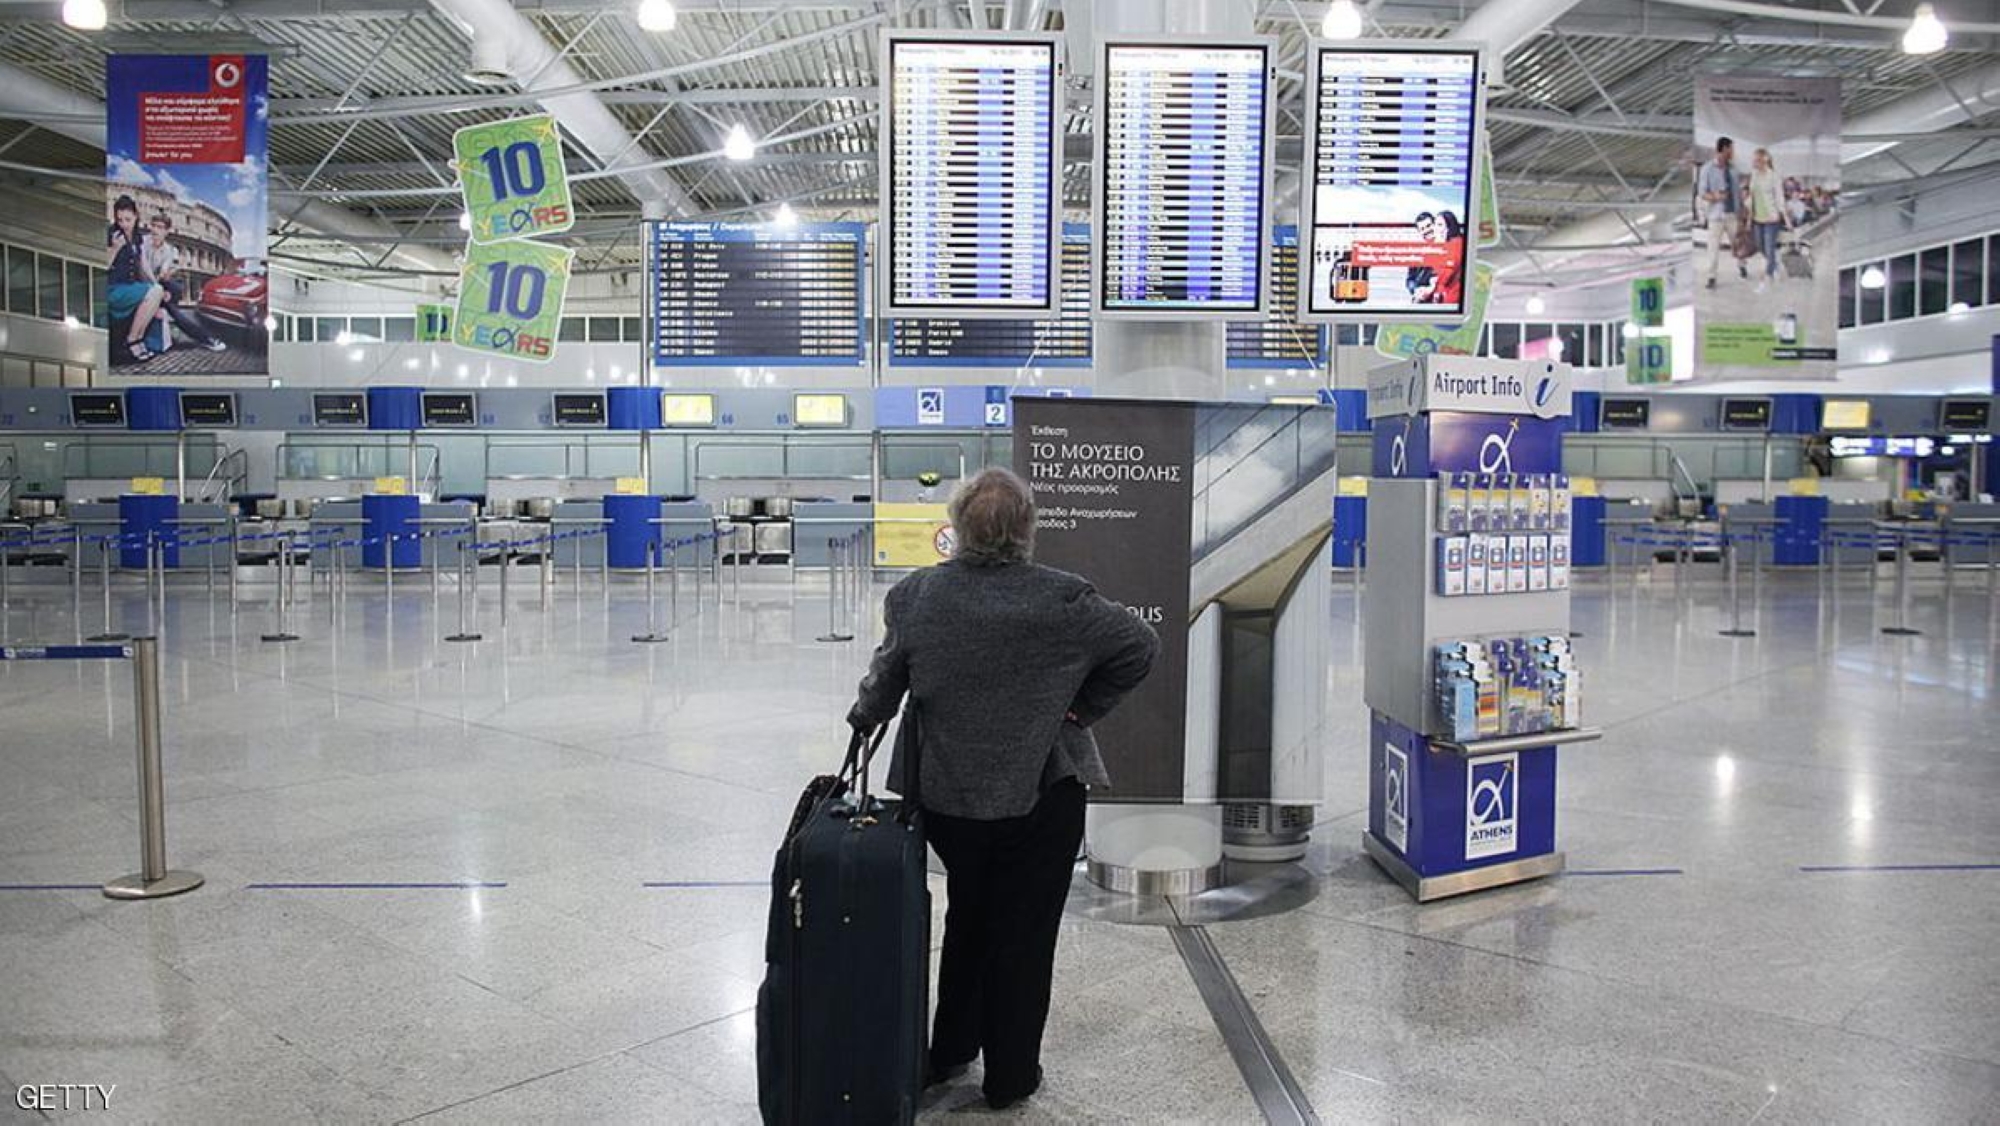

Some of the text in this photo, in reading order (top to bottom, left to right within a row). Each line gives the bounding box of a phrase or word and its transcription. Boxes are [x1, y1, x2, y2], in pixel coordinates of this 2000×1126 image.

[479, 141, 545, 201] 10
[488, 261, 545, 320] 10
[1434, 372, 1522, 398] Airport Info
[991, 406, 1002, 421] 2
[1030, 425, 1068, 437] Έκθεση
[1030, 442, 1144, 461] ΤΟ ΜΟΥΣΕΙΟ
[1030, 462, 1181, 482] ΤΗΣ ΑΚΡΟΠΟΛΗΣ
[1038, 505, 1068, 517] ίπεδο
[1038, 518, 1077, 530] σοδος 3
[1470, 825, 1513, 842] ATHENS
